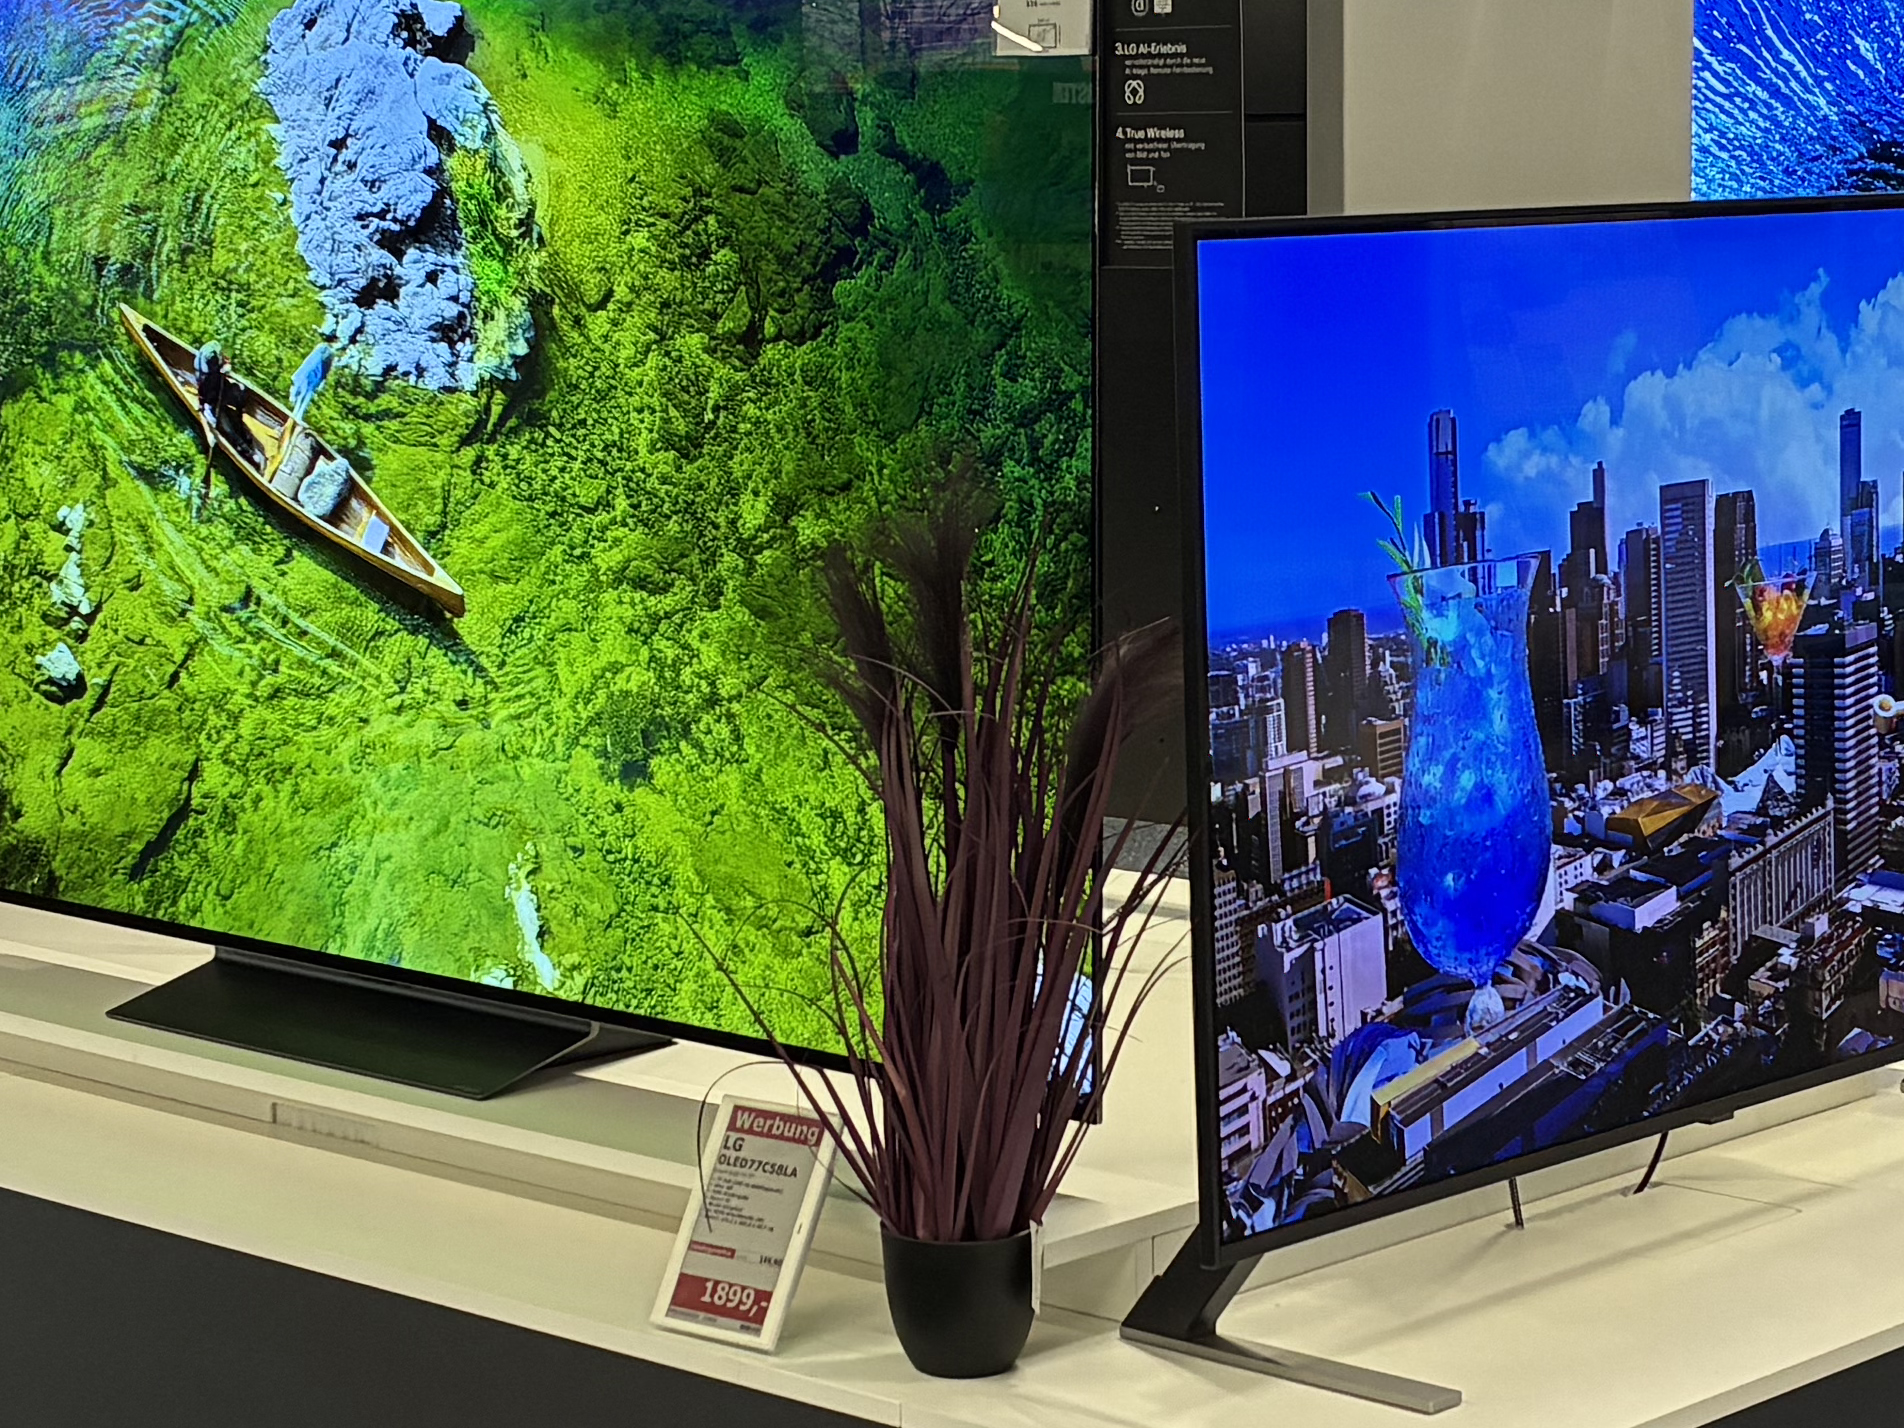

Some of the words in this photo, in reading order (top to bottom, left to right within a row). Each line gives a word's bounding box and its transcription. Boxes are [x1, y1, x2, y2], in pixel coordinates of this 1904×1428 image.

[1126, 127, 1145, 139] True
[1147, 127, 1184, 138] Wireless
[735, 1110, 820, 1144] Werbung
[723, 1134, 745, 1152] LG
[699, 1280, 769, 1317] 1899,-
